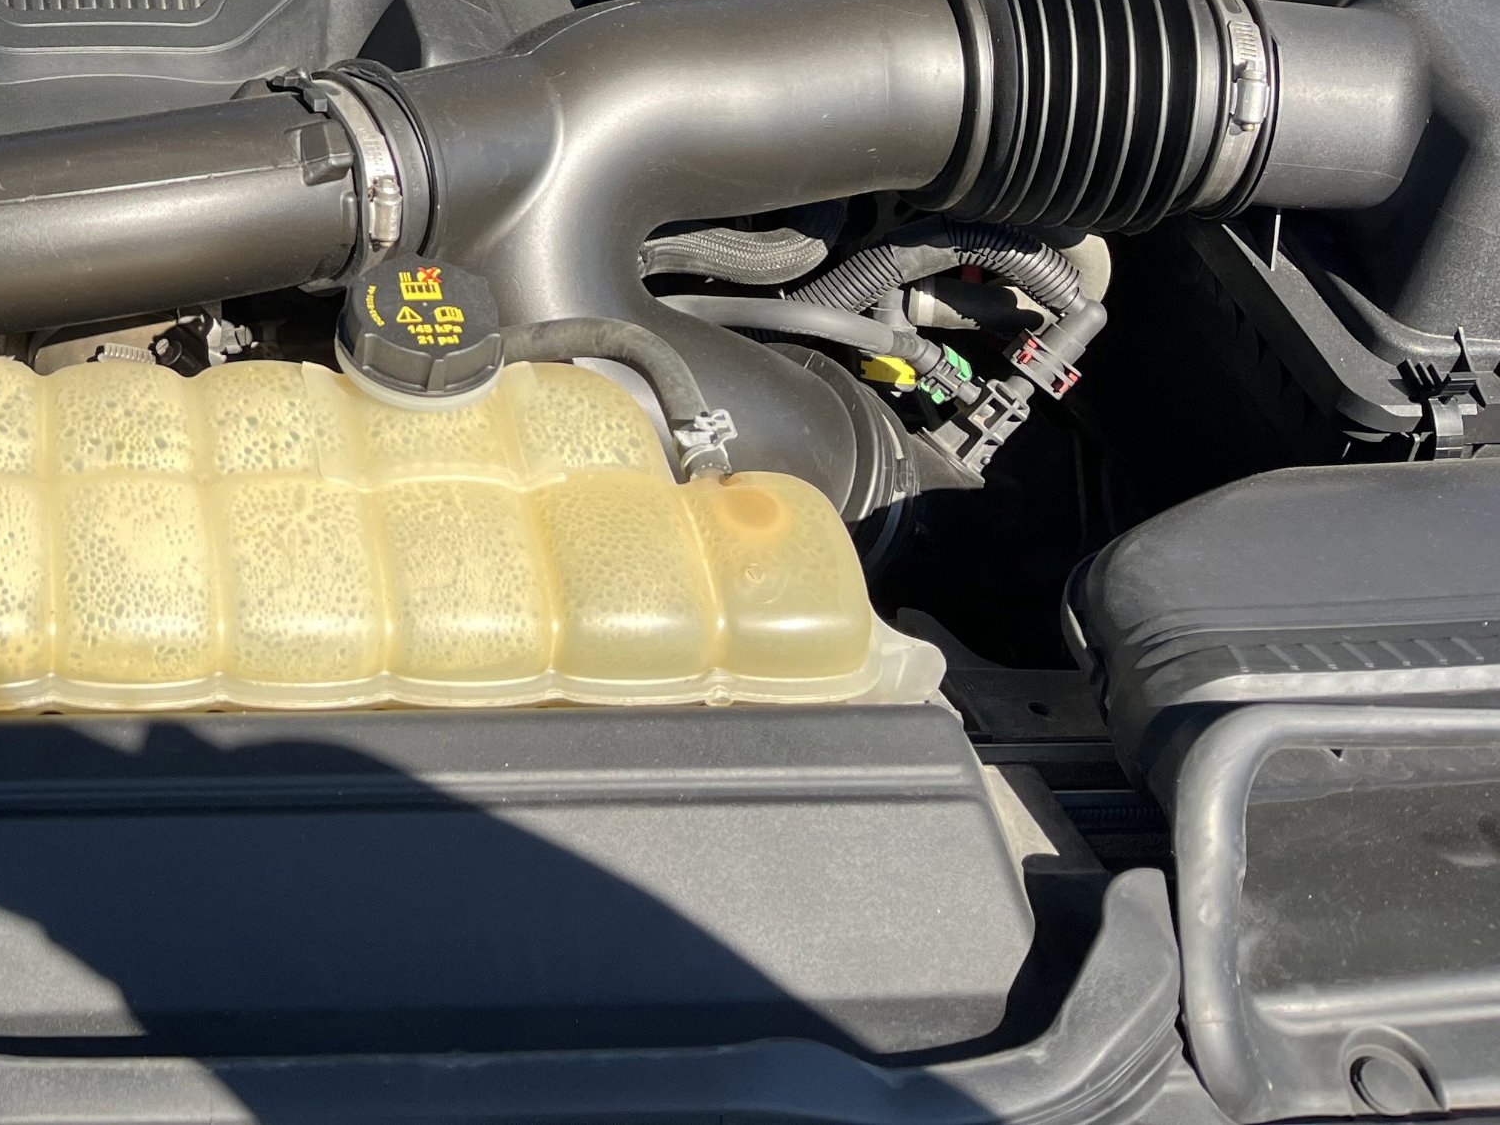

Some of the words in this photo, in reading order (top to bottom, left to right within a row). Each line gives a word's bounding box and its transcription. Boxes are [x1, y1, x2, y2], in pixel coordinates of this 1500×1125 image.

[434, 324, 463, 334] kPa
[417, 335, 434, 345] 21
[437, 335, 460, 346] psi
